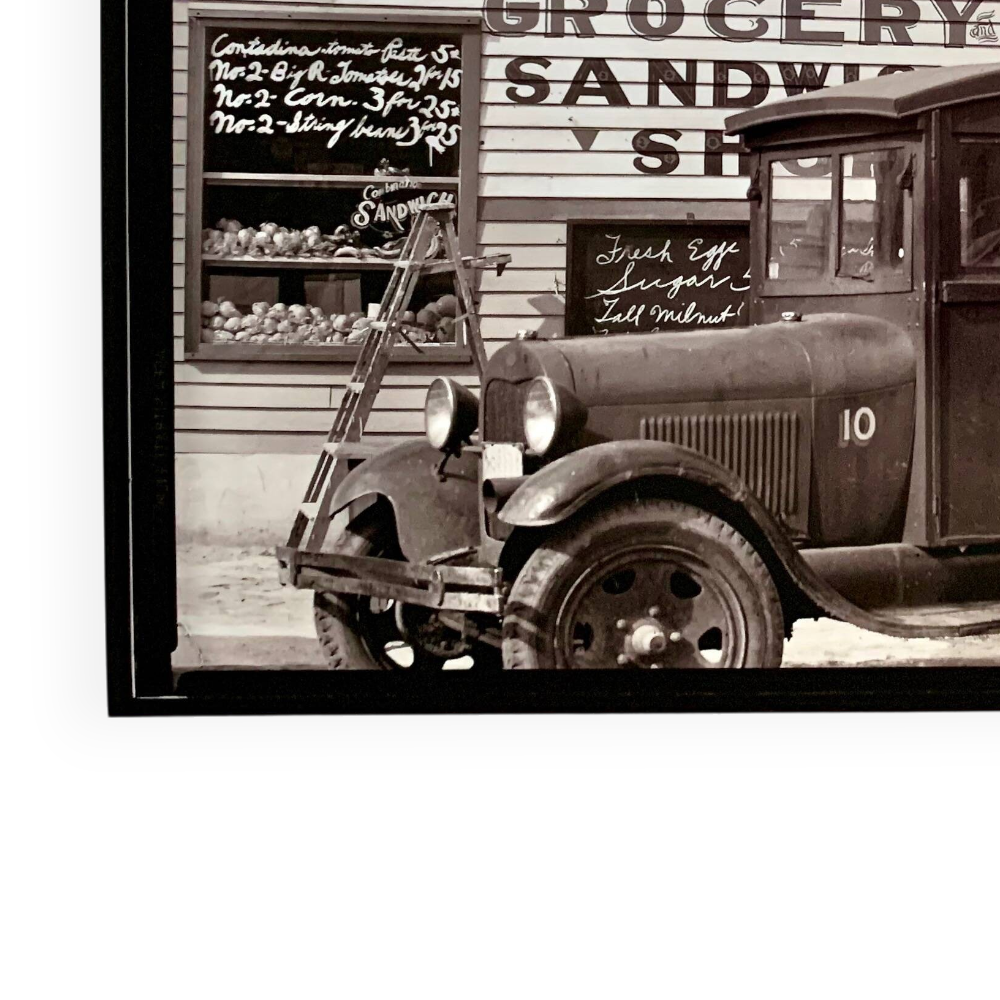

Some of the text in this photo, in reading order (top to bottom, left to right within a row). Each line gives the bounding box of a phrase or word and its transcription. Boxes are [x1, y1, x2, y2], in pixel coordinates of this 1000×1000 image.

[596, 234, 673, 265] Fresh
[584, 261, 731, 300] Sugar
[841, 406, 876, 444] 10
